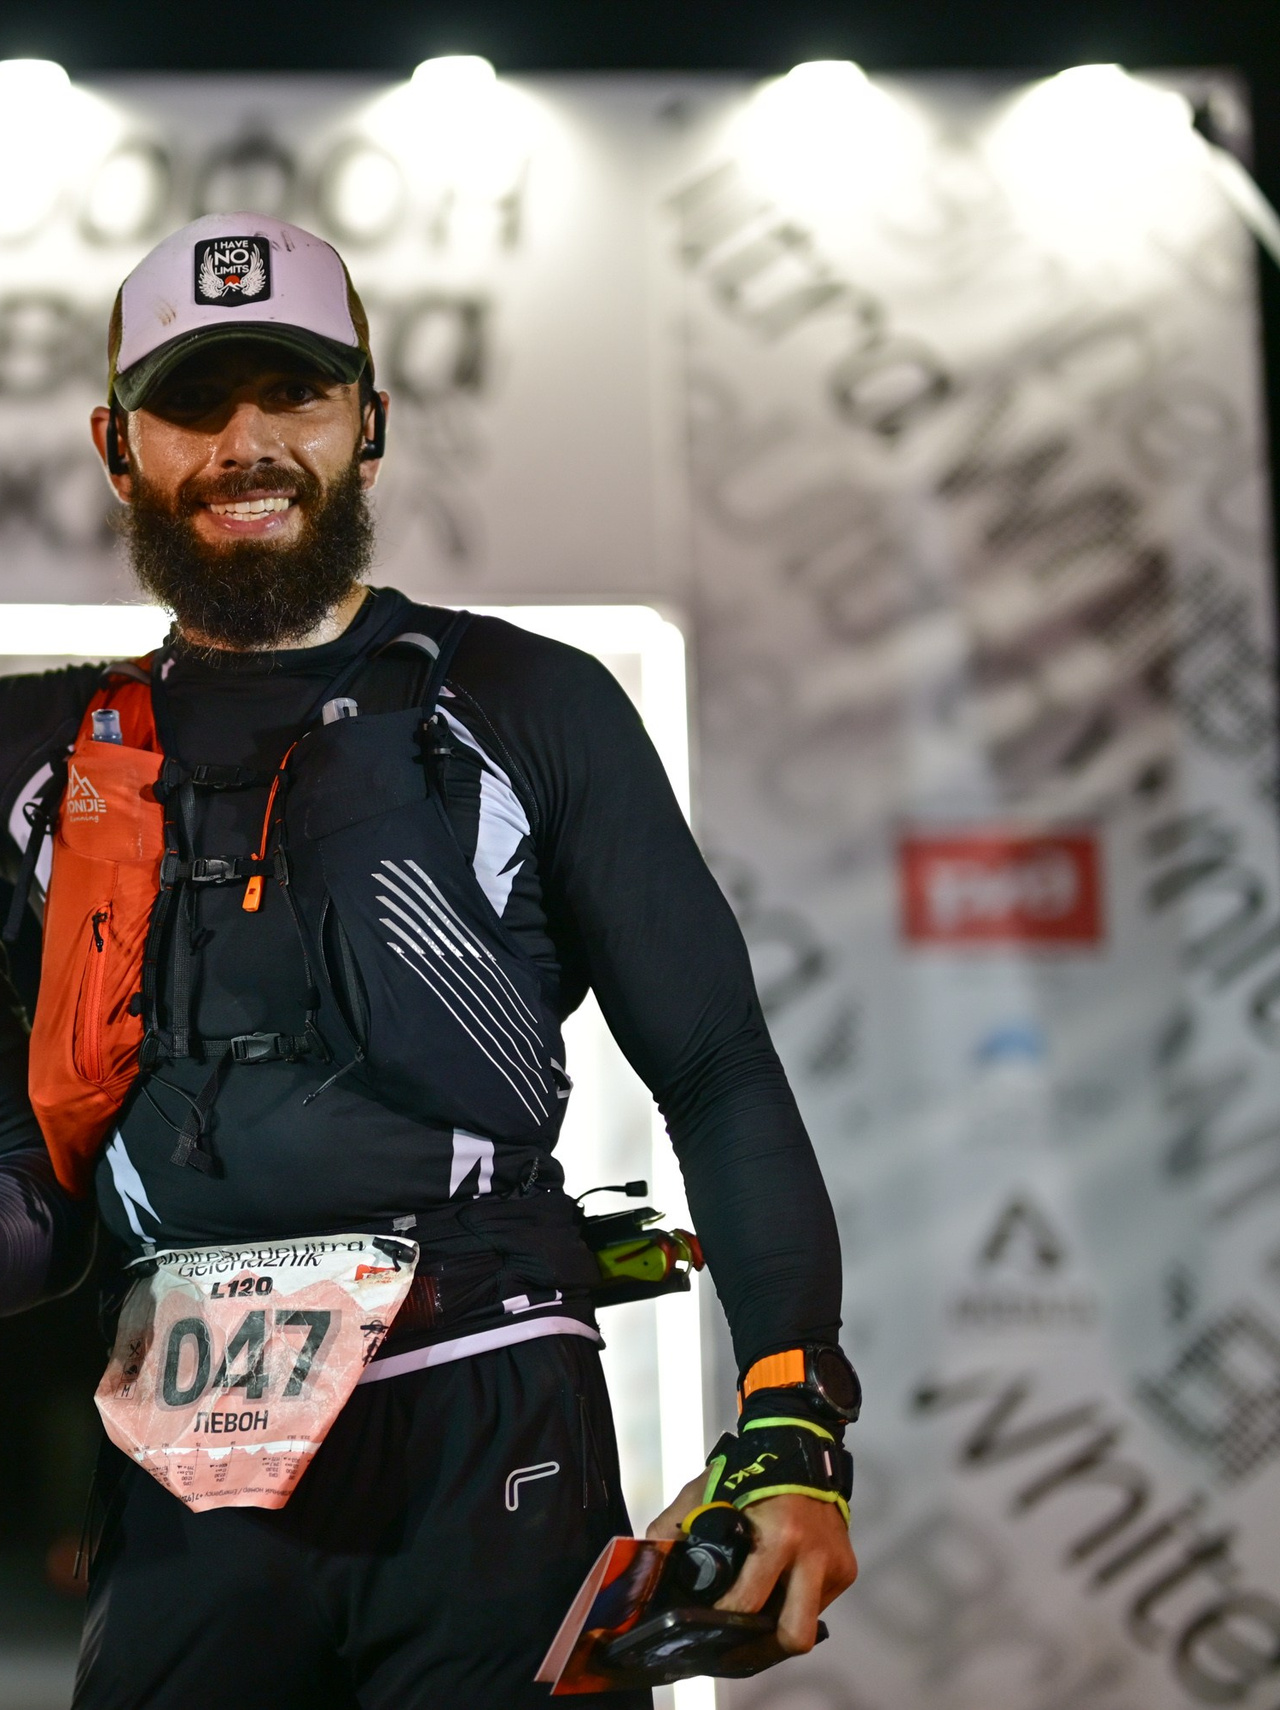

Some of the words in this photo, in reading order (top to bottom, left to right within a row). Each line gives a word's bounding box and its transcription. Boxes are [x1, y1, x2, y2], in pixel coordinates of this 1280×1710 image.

[214, 241, 218, 250] I
[220, 240, 249, 250] HAVE
[214, 248, 249, 266] NO
[214, 264, 250, 275] LIMITS
[210, 1276, 274, 1299] L120
[160, 1307, 336, 1409] 047
[193, 1411, 269, 1434] ЛЕВОН
